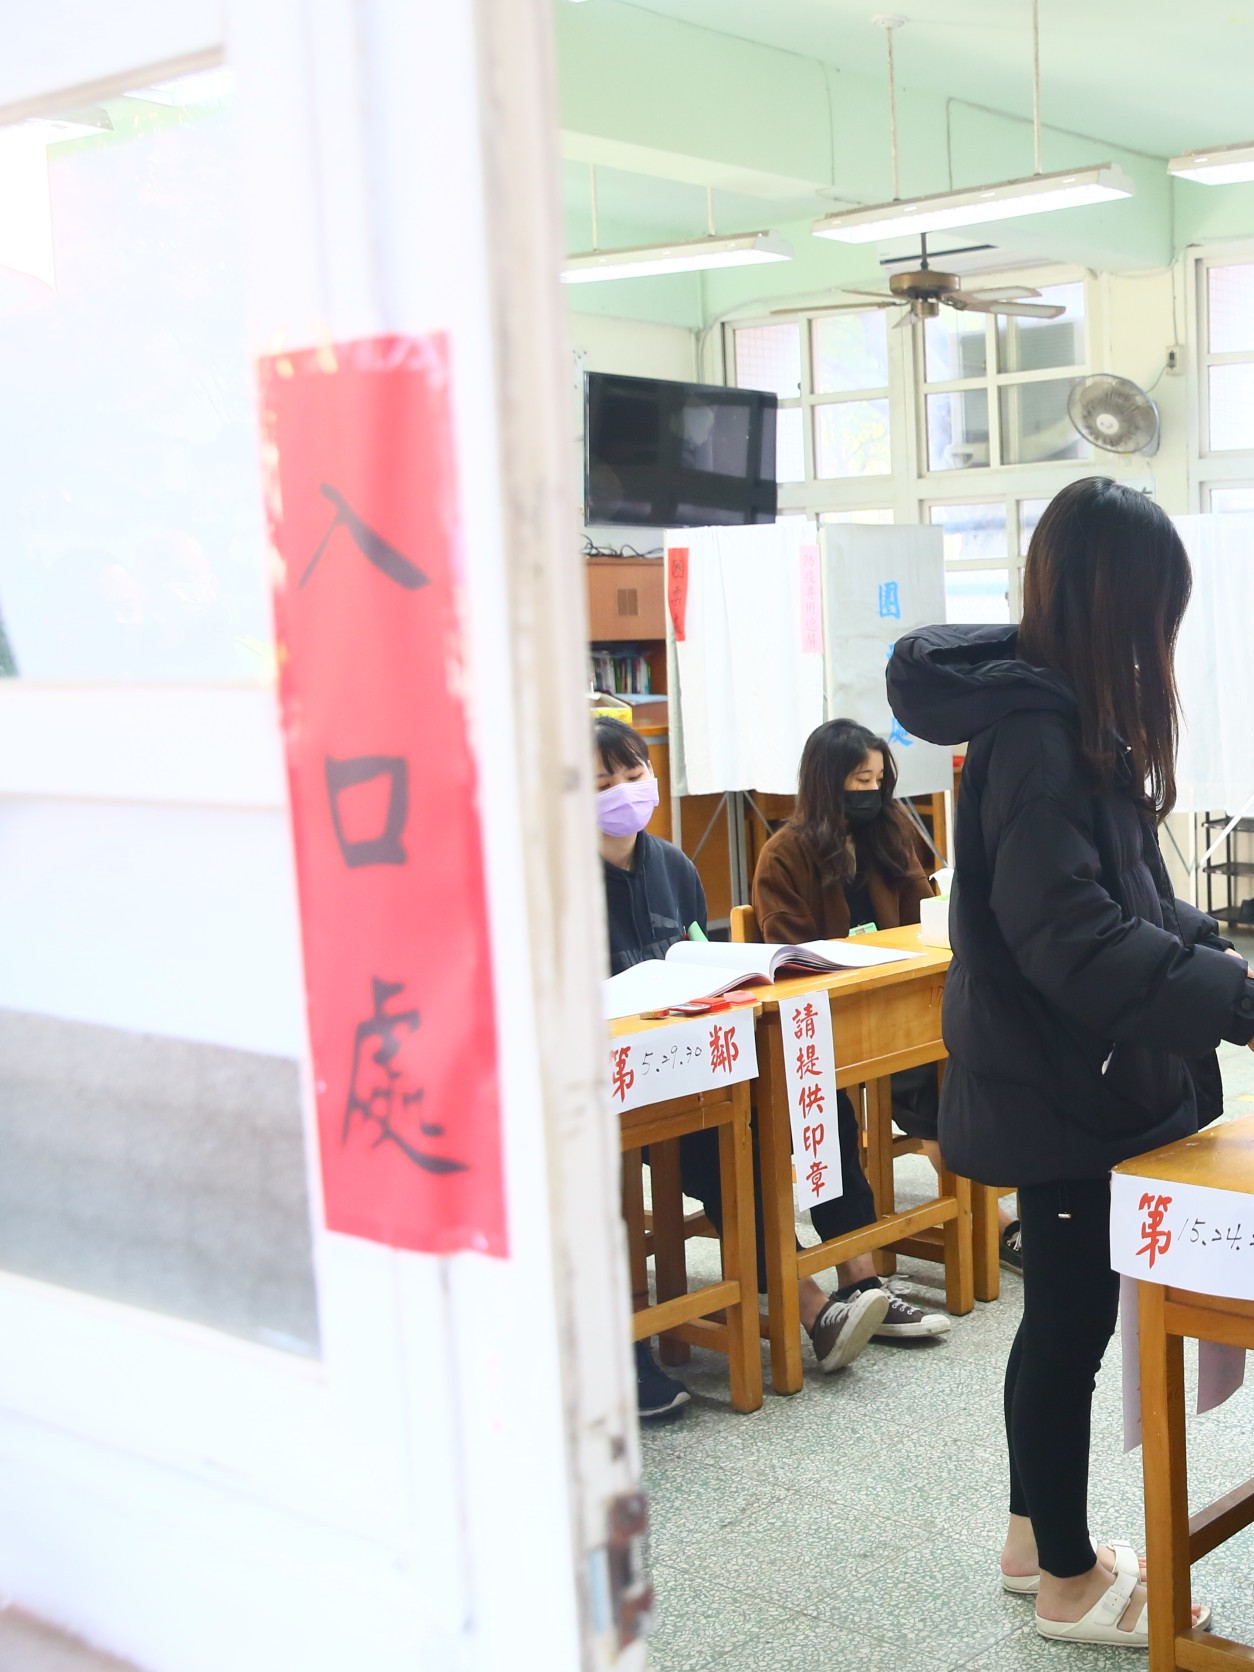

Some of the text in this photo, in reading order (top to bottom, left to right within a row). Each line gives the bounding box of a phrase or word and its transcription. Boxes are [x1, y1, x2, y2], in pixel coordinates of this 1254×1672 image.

[296, 483, 469, 1176] 入口處
[792, 1002, 828, 1198] 請提供印章
